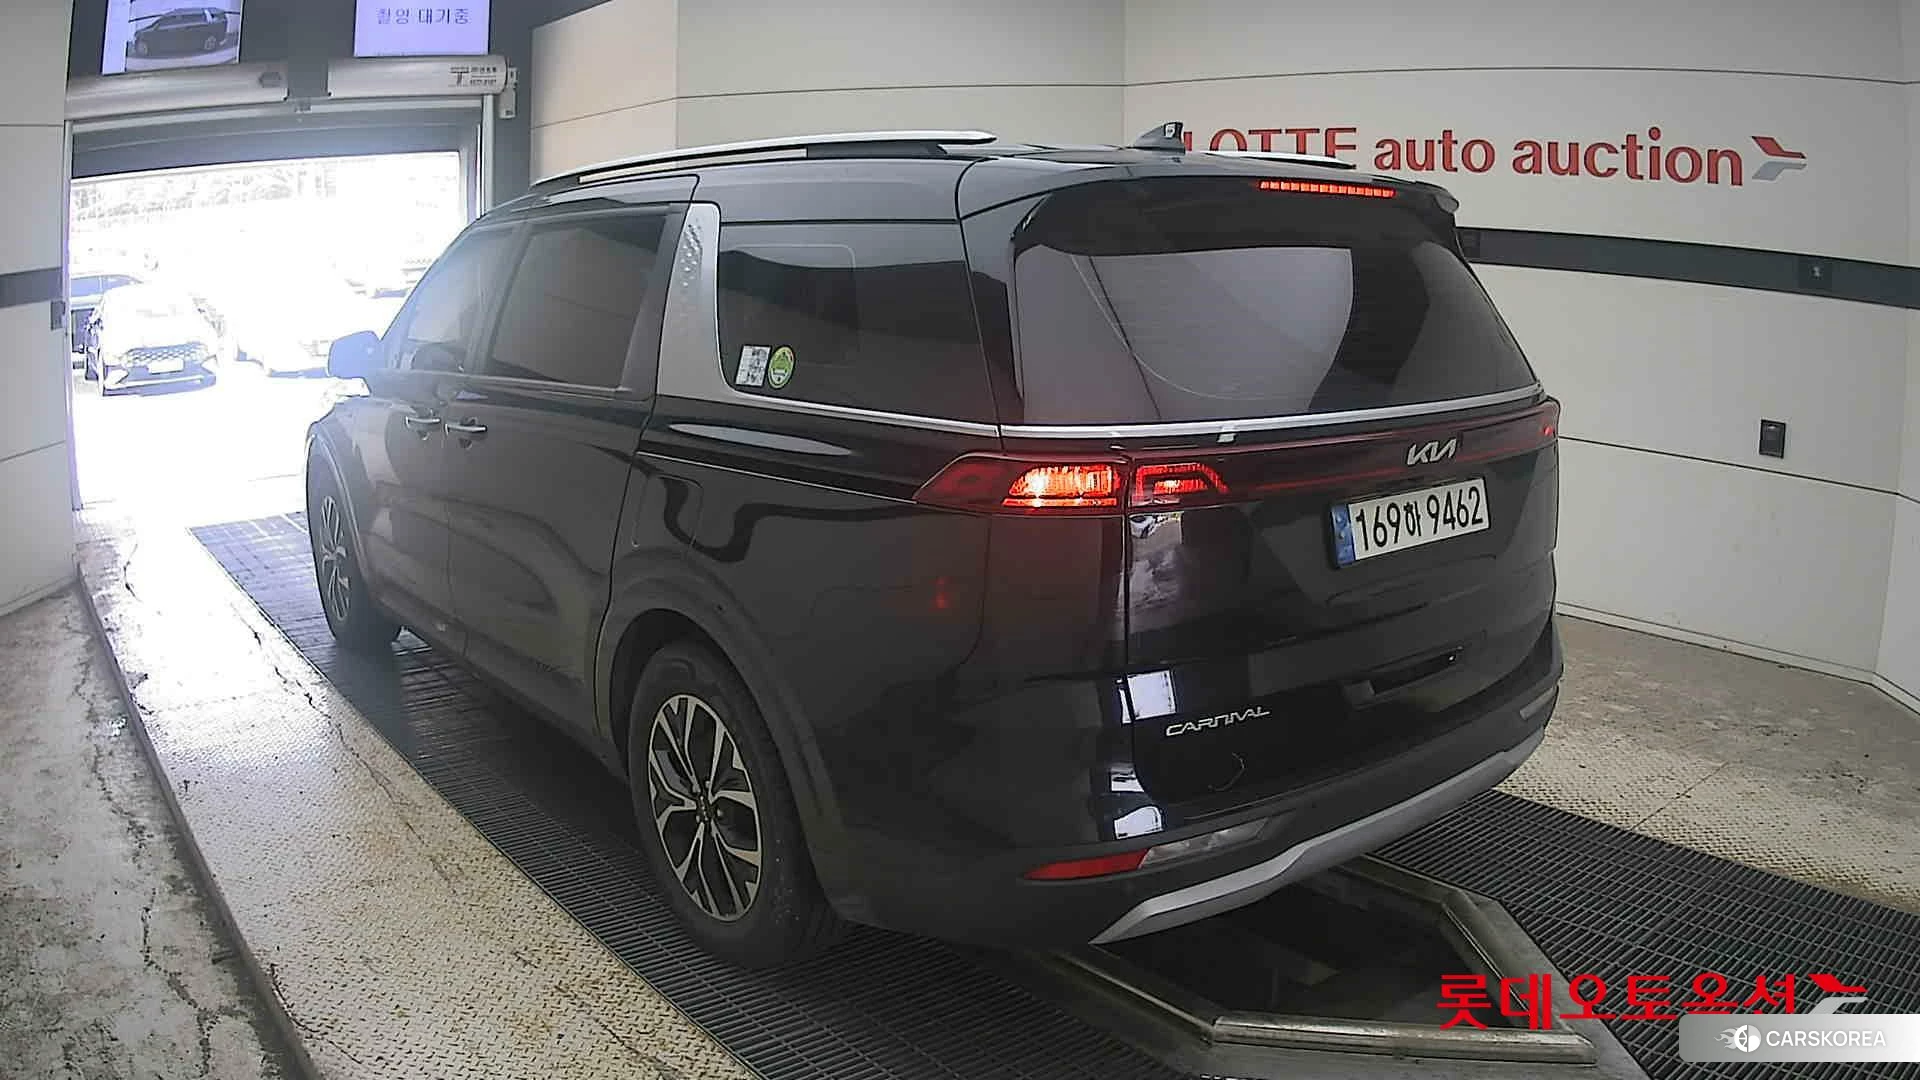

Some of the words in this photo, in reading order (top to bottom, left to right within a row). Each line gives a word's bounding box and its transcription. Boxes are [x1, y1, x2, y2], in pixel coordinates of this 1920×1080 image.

[418, 8, 470, 24] 대기중
[1373, 129, 1496, 173] auto
[1512, 126, 1743, 186] auction
[1407, 439, 1457, 466] KIA
[1355, 501, 1422, 551] 169하
[1426, 486, 1483, 535] 9462
[1166, 706, 1271, 736] CARNIVAL
